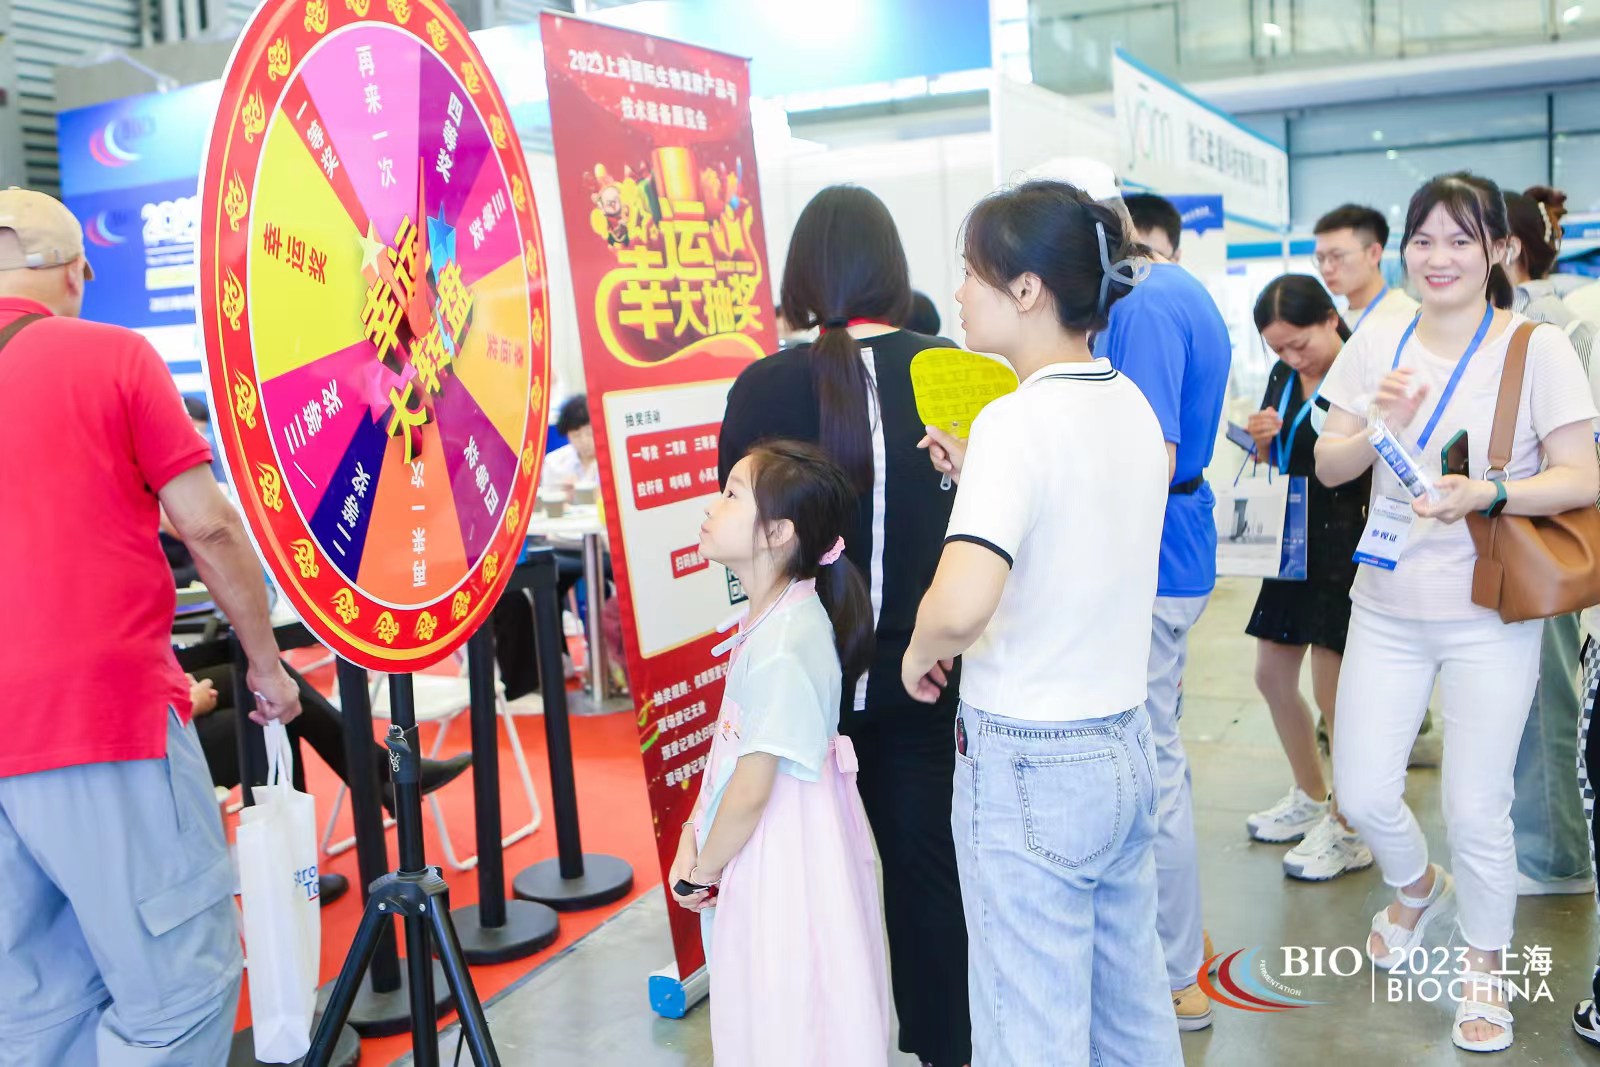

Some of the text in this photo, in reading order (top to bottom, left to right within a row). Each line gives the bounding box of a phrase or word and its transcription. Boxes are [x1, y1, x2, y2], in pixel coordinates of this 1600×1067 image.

[296, 101, 339, 179] 一等奖
[355, 45, 397, 188] 再来一次
[436, 92, 463, 183] 四等奖
[263, 223, 327, 284] 幸运奖
[469, 189, 507, 249] 三等奖
[670, 274, 764, 337] 大抽奖
[284, 379, 343, 455] 三等奖
[625, 410, 661, 428] 抽奖活动
[332, 461, 371, 556] 二等奖
[463, 435, 500, 516] 四等奖
[411, 461, 427, 587] 再来一次
